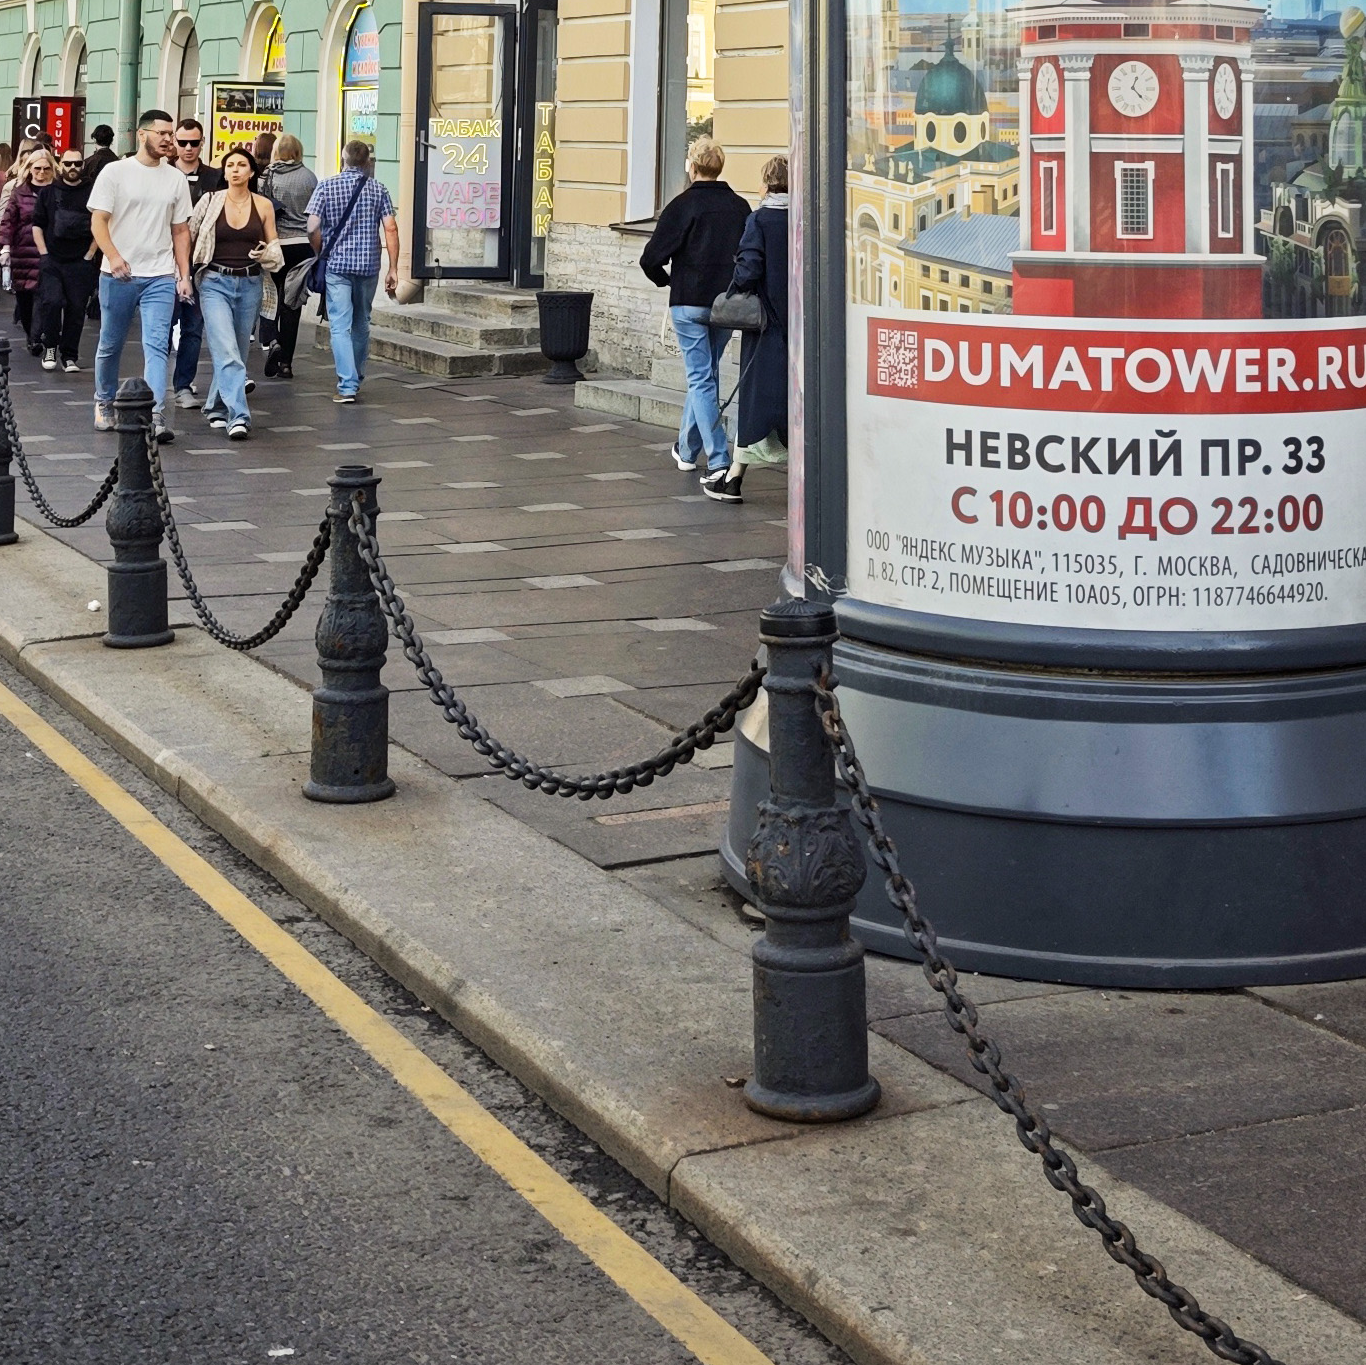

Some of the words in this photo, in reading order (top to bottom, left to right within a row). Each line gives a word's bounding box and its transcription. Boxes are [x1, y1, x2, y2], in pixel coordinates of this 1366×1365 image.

[54, 119, 63, 157] SUNL
[216, 140, 226, 152] и
[429, 118, 501, 138] ТАБАК
[441, 143, 489, 175] 24
[535, 103, 554, 237] ТАБАК
[429, 182, 500, 204] VAPE
[429, 207, 499, 228] SHOP
[945, 428, 1184, 477] НЕВСКИЙ
[1200, 437, 1273, 477] ПР.
[1282, 435, 1327, 475] 33
[951, 486, 979, 525] С
[989, 489, 1106, 533] 10:00
[1118, 496, 1199, 541] ДО
[1211, 493, 1324, 535] 22:00
[866, 528, 890, 552] ООО
[896, 533, 957, 563] "ЯНДЕКС
[961, 543, 1046, 575] МУЗЫКА",
[1051, 552, 1124, 578] 115035,
[1134, 555, 1147, 576] Г.
[1157, 555, 1239, 579] МОСКВА,
[881, 561, 898, 586] 82,
[901, 565, 927, 589] СТР.
[931, 570, 944, 594] 2,
[949, 572, 1059, 603] ПОМЕЩЕНИЕ
[1133, 586, 1186, 607] ОГРН:
[1192, 581, 1328, 607] 1187746644920.
